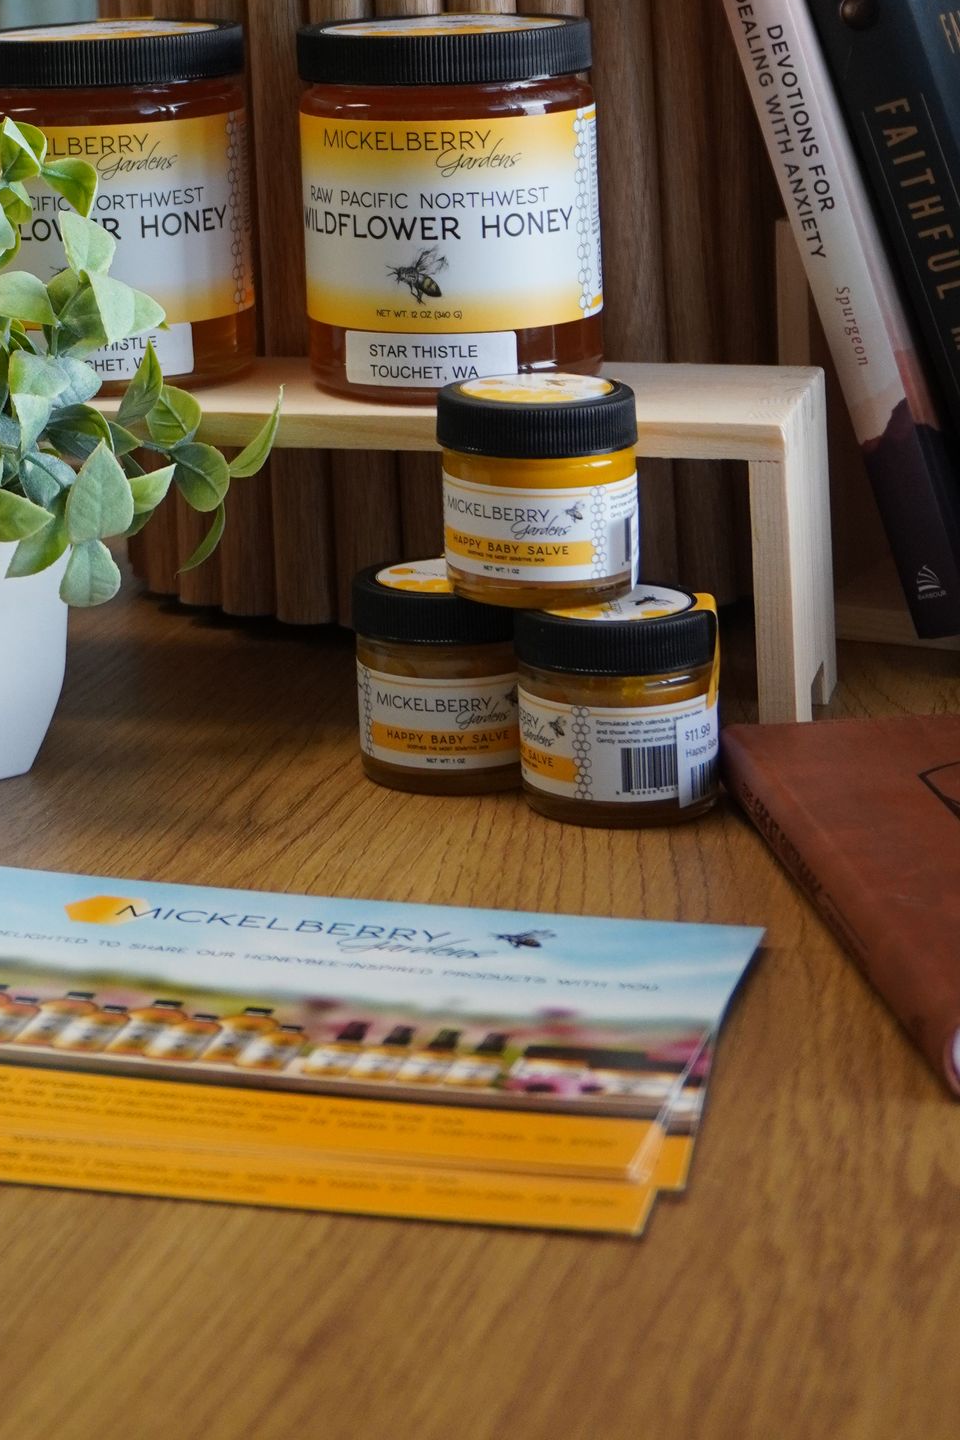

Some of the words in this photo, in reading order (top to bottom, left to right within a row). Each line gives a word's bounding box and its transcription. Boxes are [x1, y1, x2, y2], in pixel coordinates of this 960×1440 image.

[766, 23, 820, 158] DEVOTIONS
[808, 164, 836, 213] FOR
[45, 132, 150, 157] LBERRY
[323, 128, 492, 152] MICKELBERRY
[95, 140, 178, 181] Gardens
[435, 137, 523, 178] Gardens
[765, 93, 796, 155] WITH
[784, 163, 827, 259] ANXIETY
[93, 186, 204, 212] ORTHWEST
[310, 185, 334, 205] RAW
[340, 189, 409, 210] PACIFIC
[420, 186, 550, 210] NORTHWEST
[873, 96, 960, 301] FAITHFUL
[140, 204, 227, 239] HONEY
[304, 206, 461, 241] WILDFLOWER
[481, 205, 573, 240] HONEY
[376, 309, 391, 318] NET
[411, 310, 417, 318] 12
[420, 310, 432, 319] OZ
[453, 310, 463, 320] G)
[835, 286, 869, 366] Spurgeon
[369, 343, 408, 358] STAR
[411, 344, 479, 359] THISTLE
[370, 364, 448, 381] TOUCHET,
[452, 365, 480, 379] WA
[447, 493, 551, 523] MICKELBERRY
[510, 514, 573, 541] Gardens
[453, 533, 481, 550] HAPPY
[487, 542, 520, 555] BABY
[527, 545, 569, 556] SALVE
[376, 691, 493, 713] MICKELBERRY
[455, 701, 512, 731] Gardens
[386, 729, 425, 742] HAPPY
[431, 734, 465, 745] BABY
[471, 730, 510, 743] SALVE
[685, 722, 712, 742] $11.99
[528, 749, 554, 768] SALVE
[685, 746, 707, 758] Happy
[115, 904, 452, 943] MICKELBERRY
[335, 934, 498, 961] Gardens
[97, 939, 123, 949] TO
[128, 942, 189, 955] SHARE
[195, 948, 237, 958] OUR
[243, 952, 434, 976] HONEYBEE-INSPIRED
[441, 969, 548, 985] PRODUCTS
[556, 978, 609, 989] WITH
